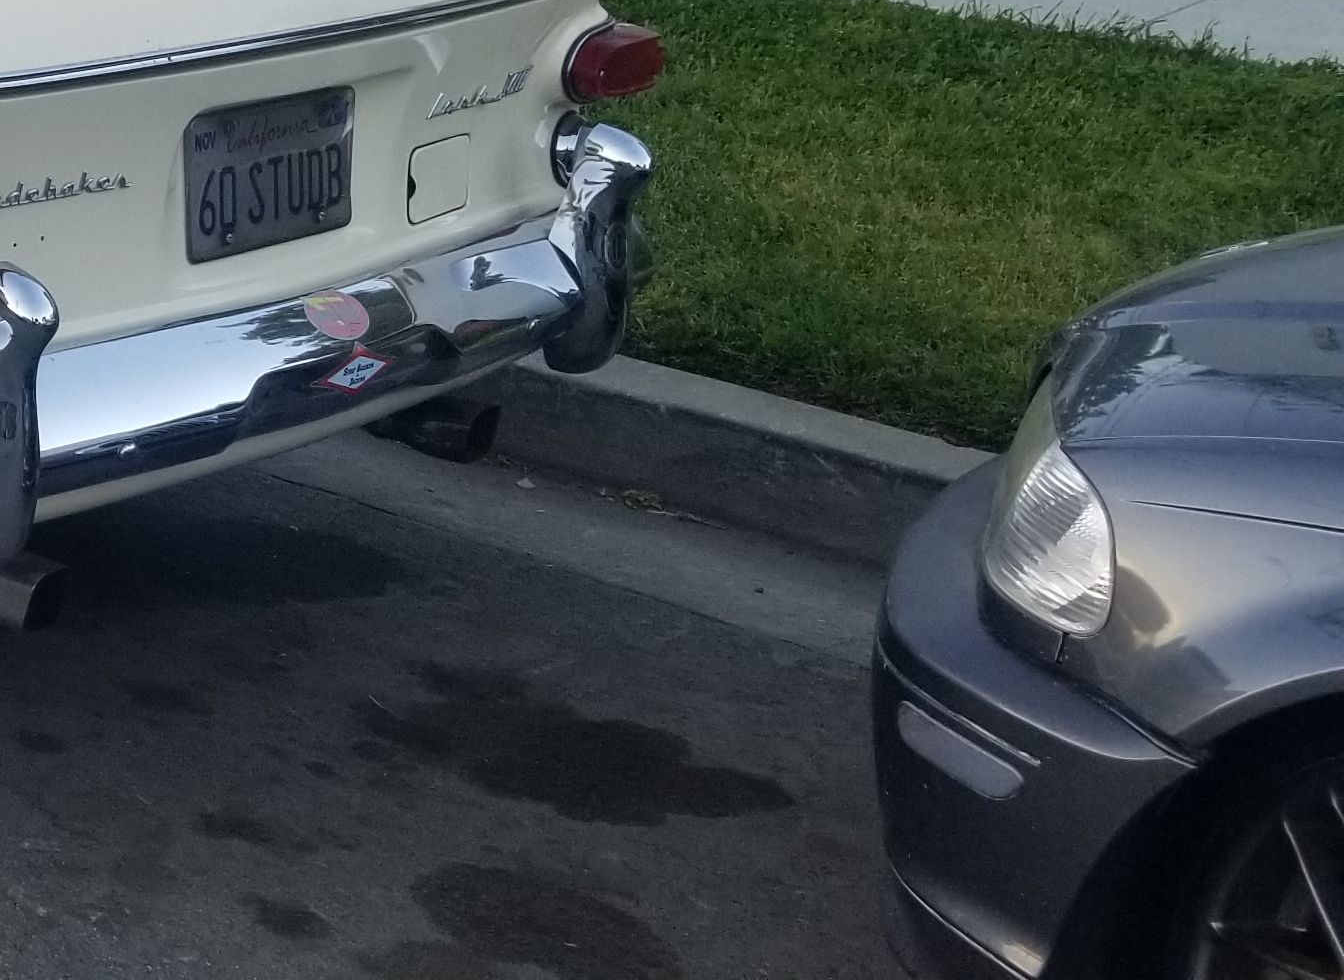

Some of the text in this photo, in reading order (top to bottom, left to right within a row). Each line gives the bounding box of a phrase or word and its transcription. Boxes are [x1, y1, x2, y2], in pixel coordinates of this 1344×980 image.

[194, 130, 216, 153] NOV
[198, 142, 343, 237] 60 STUDB
